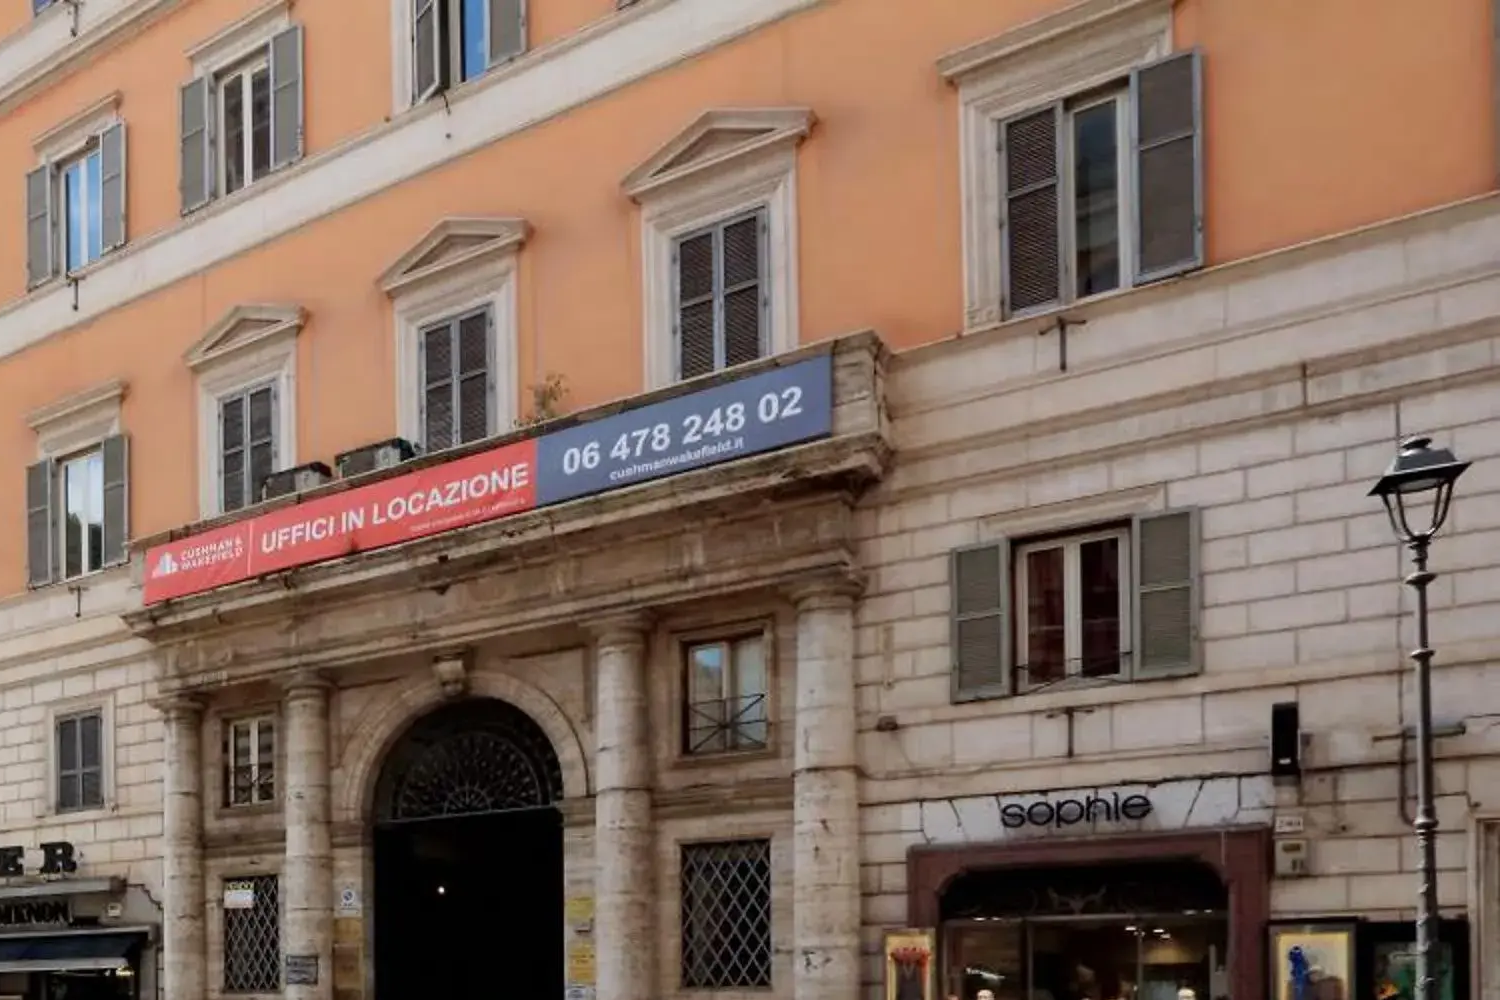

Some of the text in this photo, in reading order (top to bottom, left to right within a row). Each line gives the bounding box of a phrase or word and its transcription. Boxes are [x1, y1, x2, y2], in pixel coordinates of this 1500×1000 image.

[563, 385, 803, 475] 06 478 248 02
[261, 515, 335, 552] UFFICI
[341, 506, 364, 532] IN
[371, 463, 529, 525] LOCAZIONE
[1001, 792, 1153, 828] sophie
